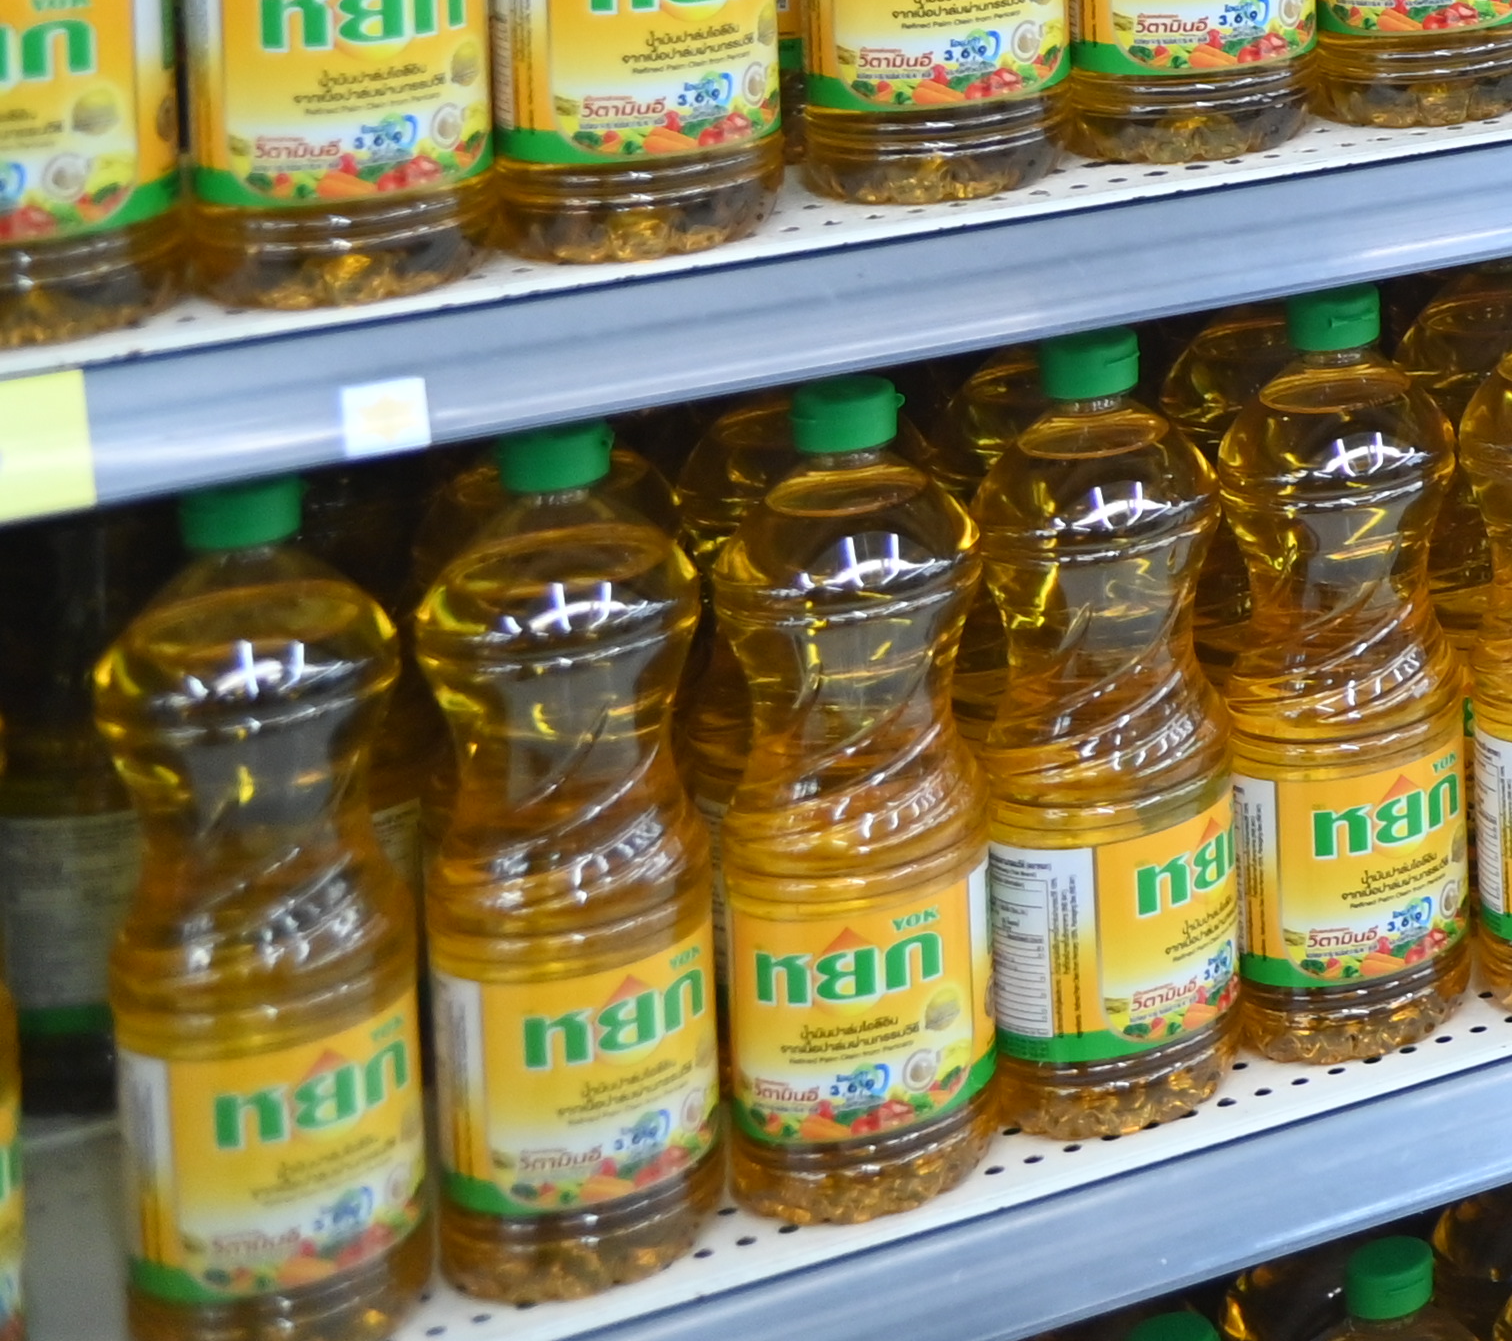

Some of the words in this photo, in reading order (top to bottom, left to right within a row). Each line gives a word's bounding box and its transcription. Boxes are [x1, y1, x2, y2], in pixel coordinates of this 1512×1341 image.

[858, 51, 934, 68] วิตามินอี
[1315, 775, 1457, 855] หยก
[1138, 825, 1234, 915] หย
[758, 935, 938, 1002] หยก
[1307, 926, 1380, 948] วิตามินอี
[526, 972, 700, 1065] หยก
[216, 1053, 404, 1143] หยก
